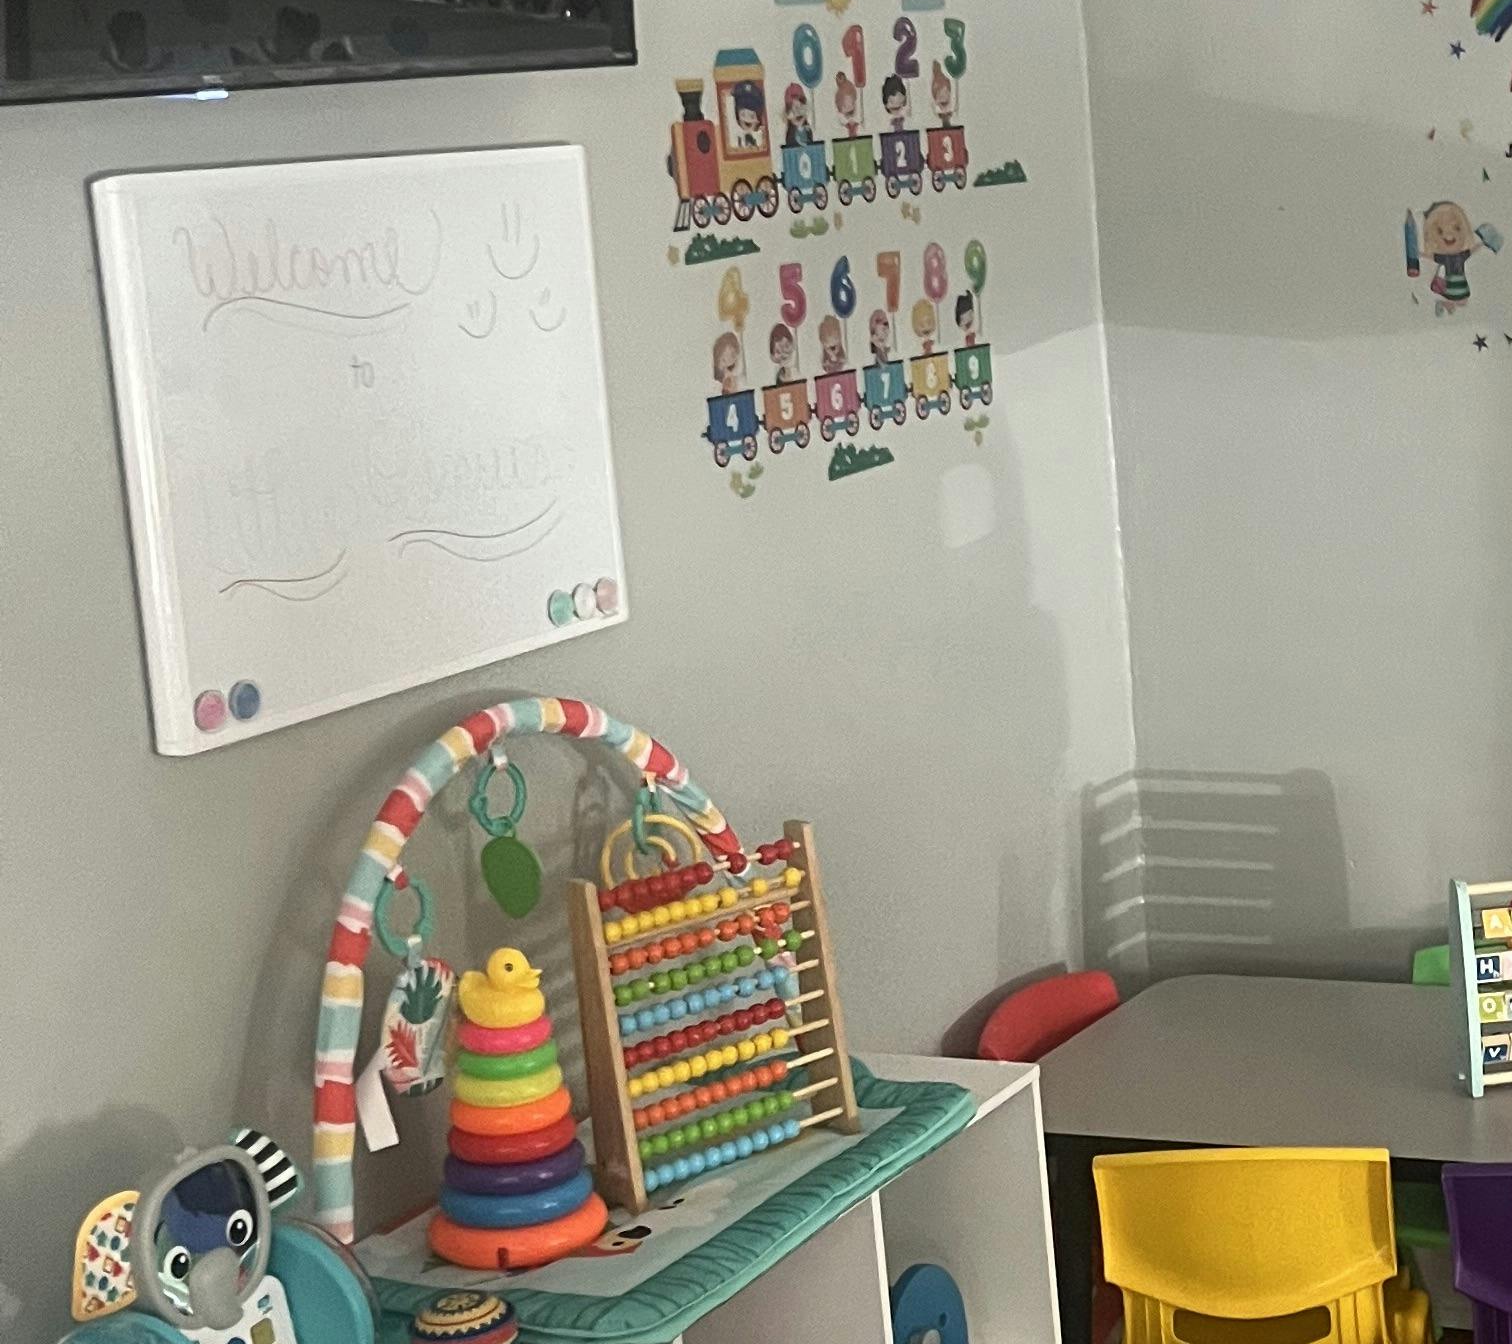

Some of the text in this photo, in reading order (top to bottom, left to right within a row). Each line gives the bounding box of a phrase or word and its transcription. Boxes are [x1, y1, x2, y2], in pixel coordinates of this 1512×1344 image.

[842, 24, 867, 88] 1
[893, 16, 919, 78] 2
[943, 18, 968, 79] 3
[894, 140, 908, 167] 2
[942, 136, 953, 162] 3
[718, 265, 750, 330] 4
[779, 262, 807, 328] 5
[830, 256, 857, 319] 6
[877, 251, 901, 313] 7
[923, 242, 948, 304] 8
[726, 403, 740, 432] 4
[780, 392, 795, 418] 5
[831, 384, 843, 410] 6
[880, 374, 891, 399] 7
[1480, 959, 1494, 974] H
